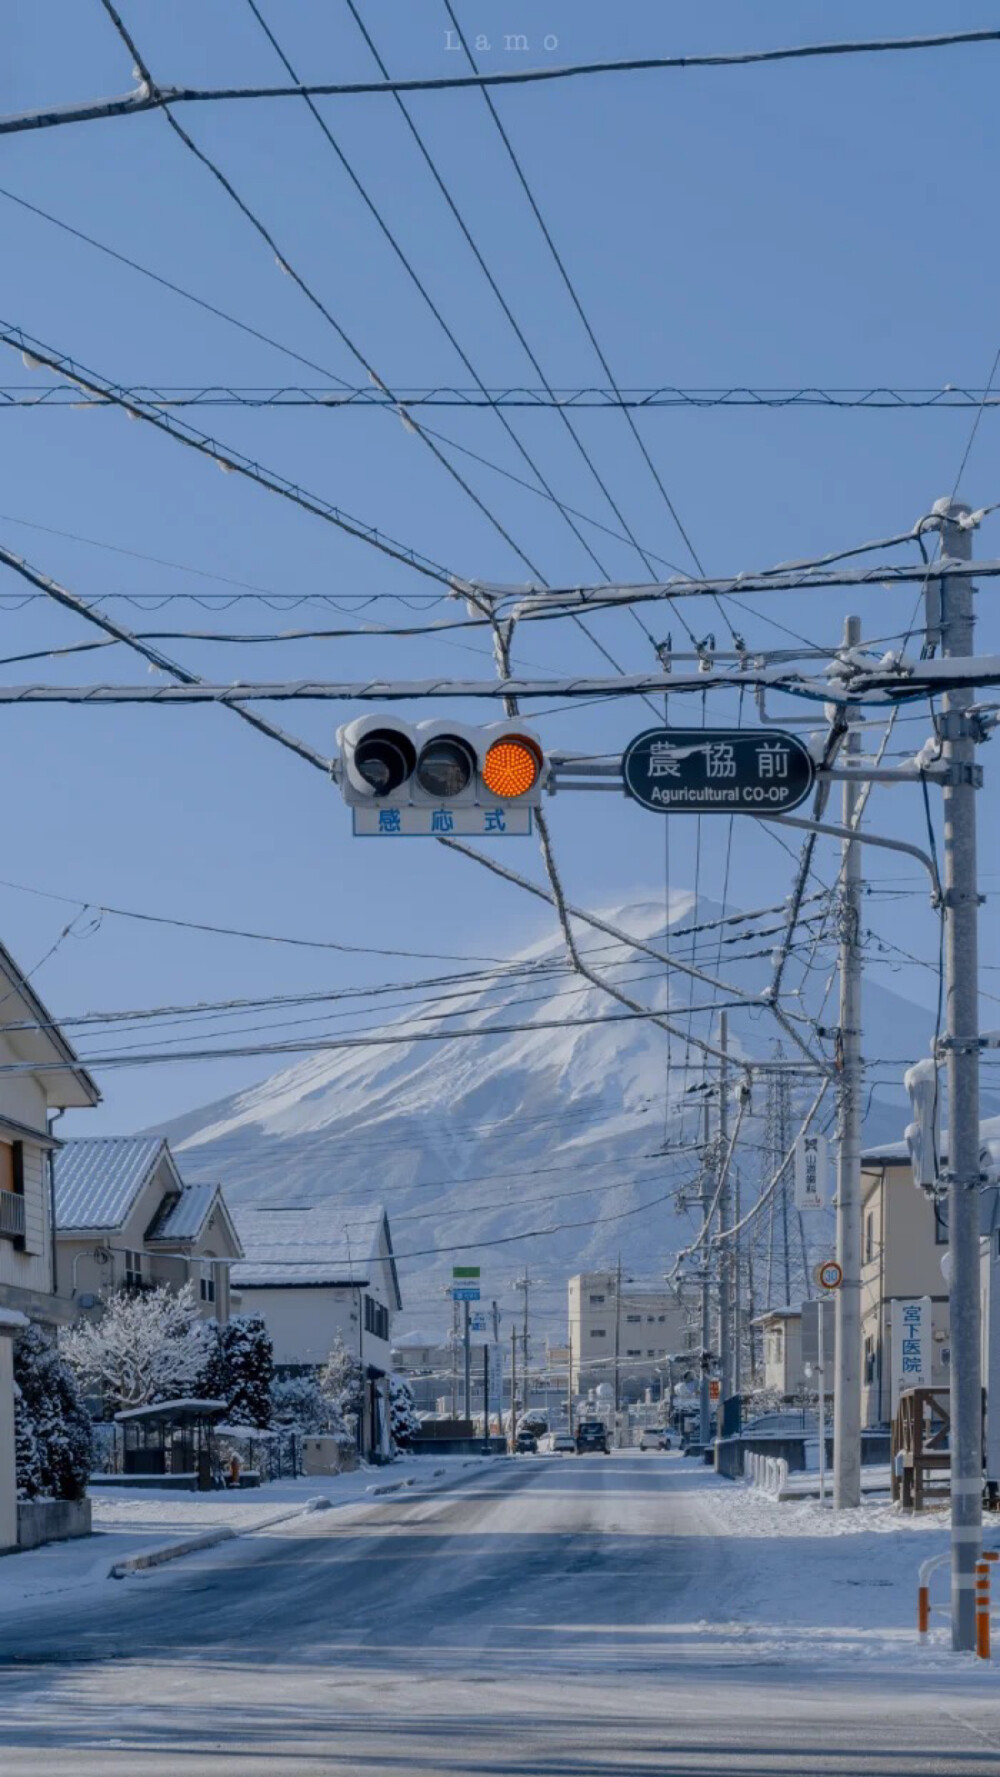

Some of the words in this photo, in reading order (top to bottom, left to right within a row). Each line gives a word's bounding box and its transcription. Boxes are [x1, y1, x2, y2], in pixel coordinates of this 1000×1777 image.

[647, 740, 790, 778] 農協前
[651, 786, 739, 803] Aguricultural
[742, 787, 789, 801] CO-OP
[379, 804, 506, 832] 感応式
[902, 1305, 922, 1373] 宮下医院
